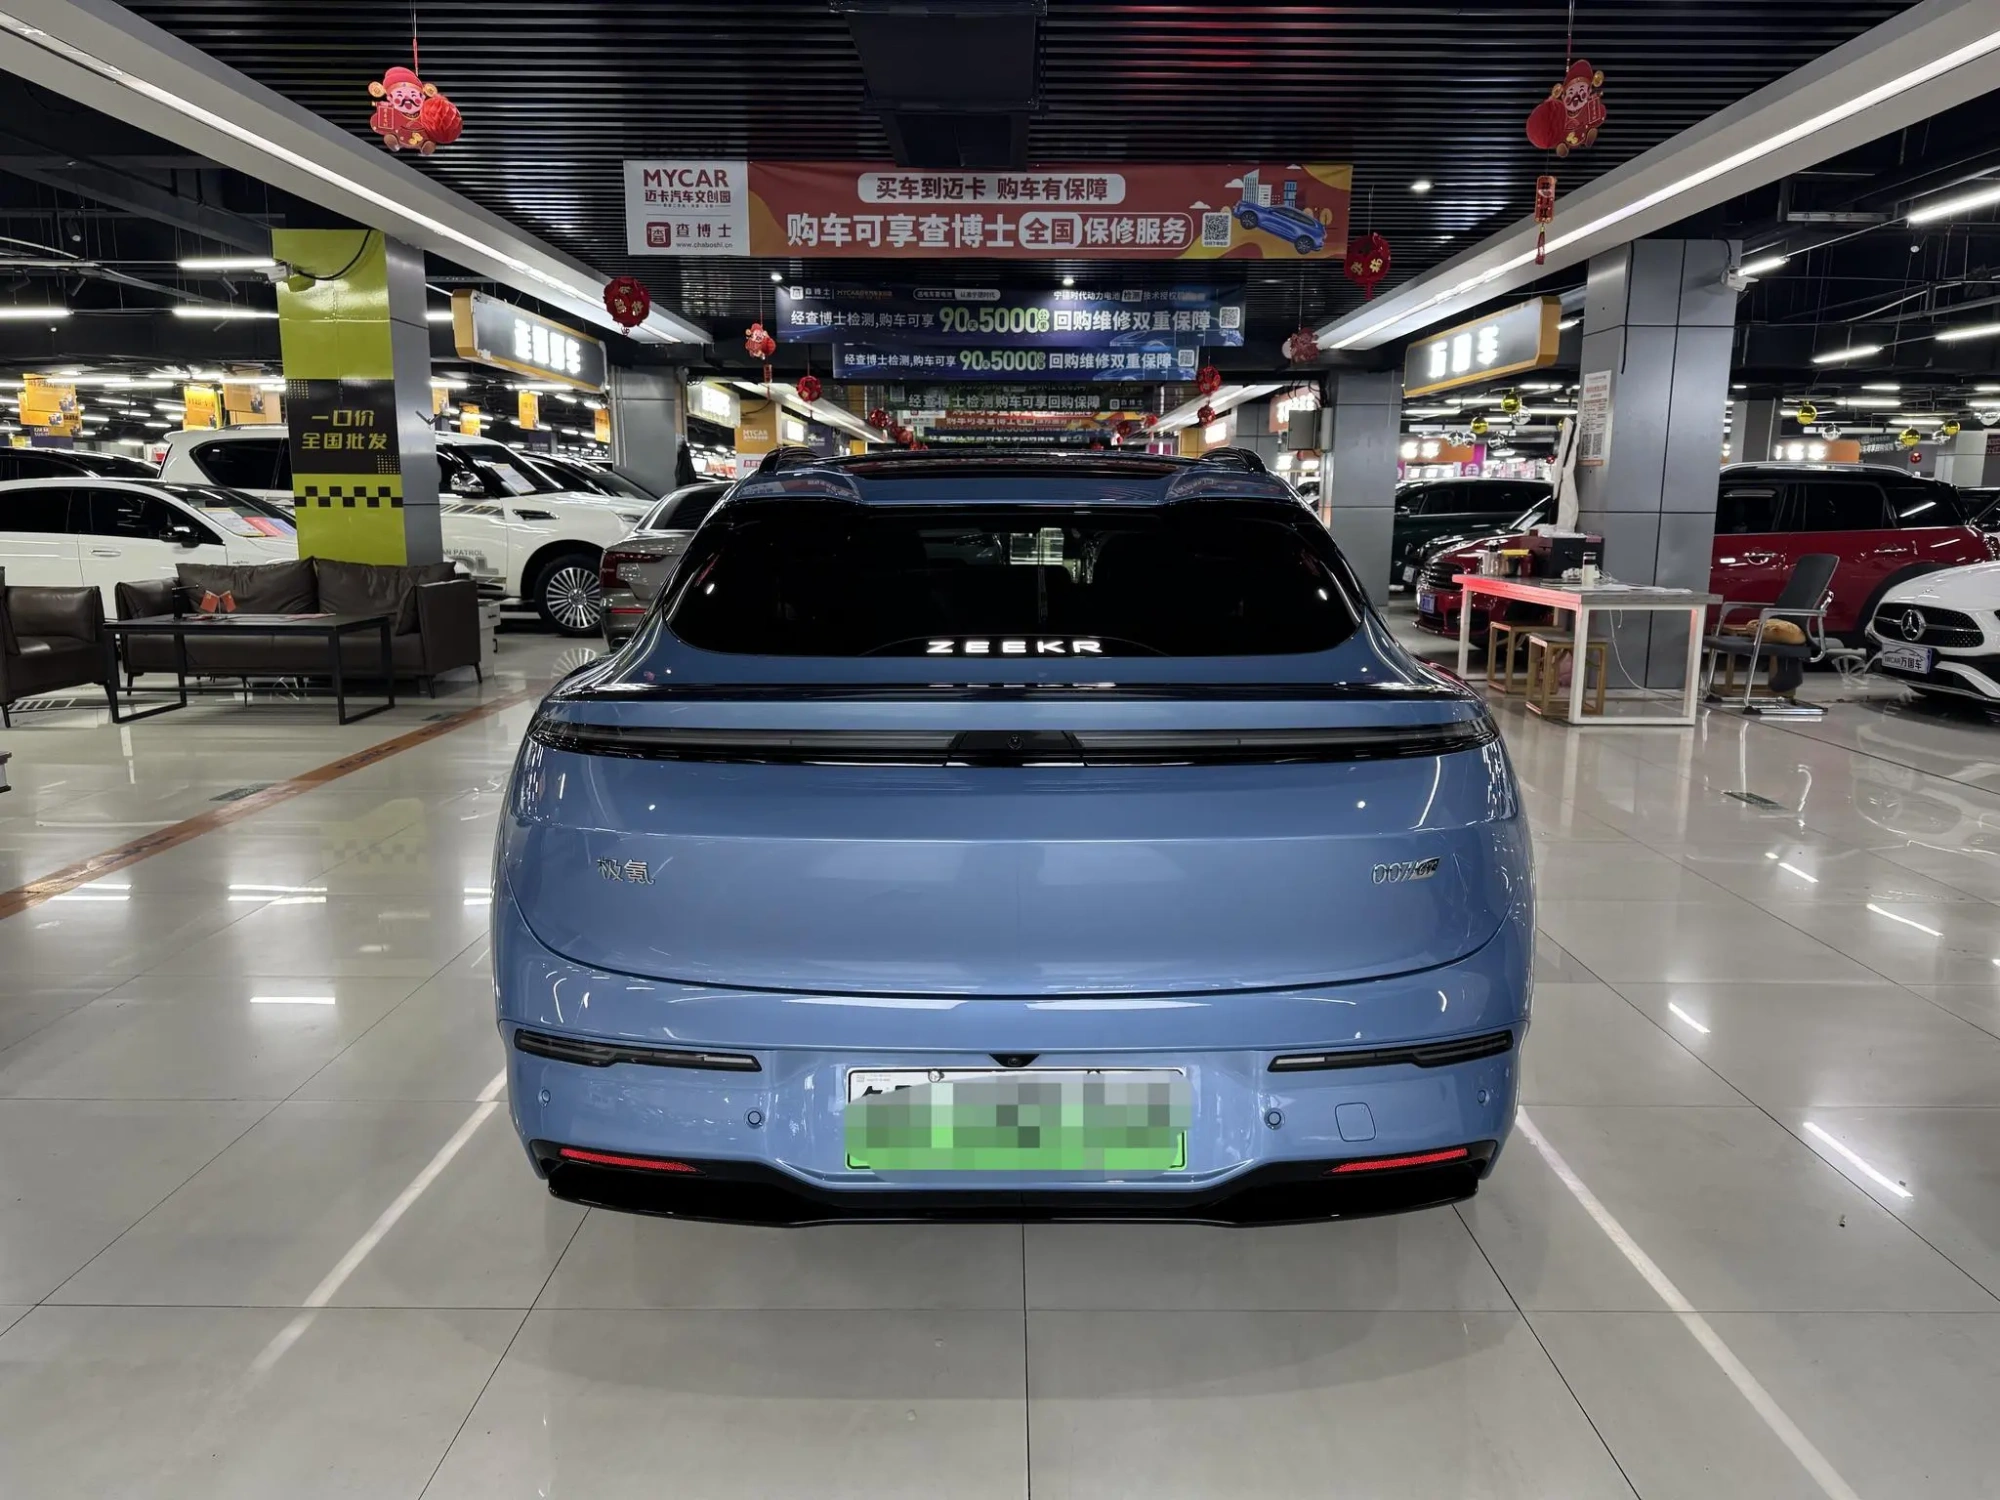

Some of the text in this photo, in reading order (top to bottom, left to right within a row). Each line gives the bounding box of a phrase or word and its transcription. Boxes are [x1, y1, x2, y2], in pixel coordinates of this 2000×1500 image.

[643, 169, 729, 188] MYCAR
[644, 189, 731, 204] 迈卡汽车文创园
[876, 177, 1108, 200] 买车到迈卡 购车有保障
[675, 222, 732, 238] 查博士
[787, 213, 1188, 249] 购车可享查博士全国保修服务
[676, 241, 733, 249] www.chaboshi.cn
[790, 309, 935, 329] 经查博士检测,购车可享
[1053, 310, 1211, 332] 回购维修双重保障
[843, 353, 956, 368] 经查博士检测,购车可享
[1049, 352, 1172, 370] 回购维修双重保障
[311, 409, 374, 427] 一口价
[301, 432, 388, 450] 全国批发
[453, 548, 484, 556] PATROL
[926, 641, 1103, 654] ZEEKR
[597, 857, 655, 885] 极氪
